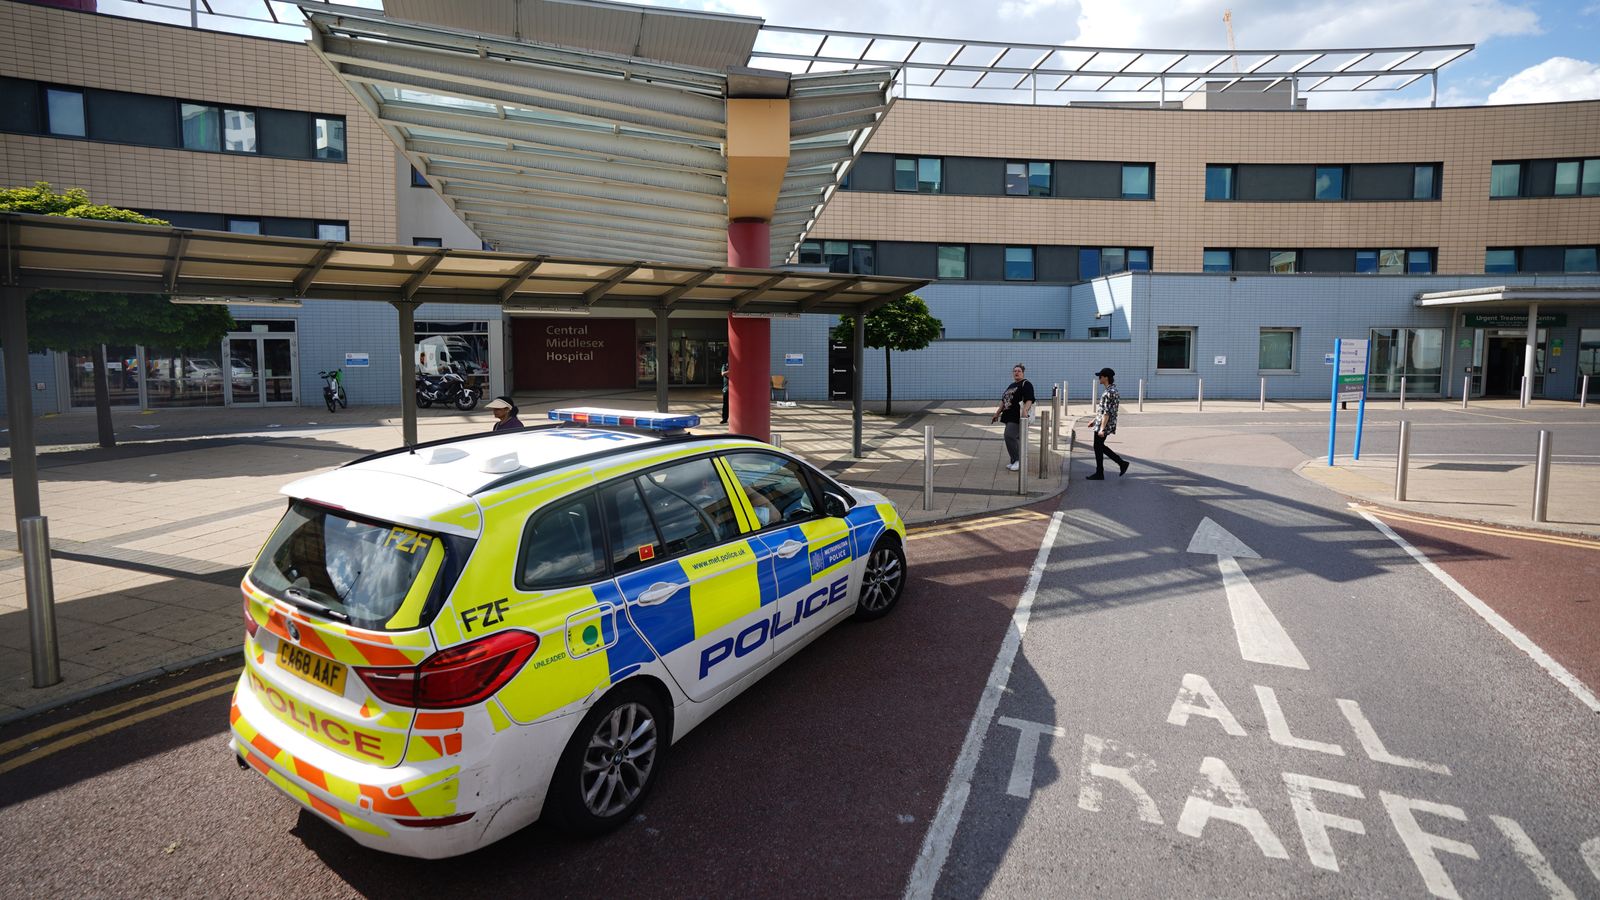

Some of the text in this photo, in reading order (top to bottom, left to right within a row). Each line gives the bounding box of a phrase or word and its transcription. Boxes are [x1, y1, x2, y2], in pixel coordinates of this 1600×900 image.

[546, 324, 588, 335] Central
[546, 337, 605, 348] Middlesex
[546, 350, 594, 363] Hospital
[383, 527, 434, 554] FZF
[824, 540, 848, 555] METROPOLITAN
[692, 547, 746, 571] www.met.police.uk
[829, 549, 846, 563] POLICE
[460, 597, 510, 633] FZF
[698, 575, 849, 681] POLICE
[280, 642, 341, 687] CA68 AAF
[533, 652, 566, 670] UNLEADED
[251, 672, 385, 761] POLICE
[1166, 673, 1452, 776] ALL
